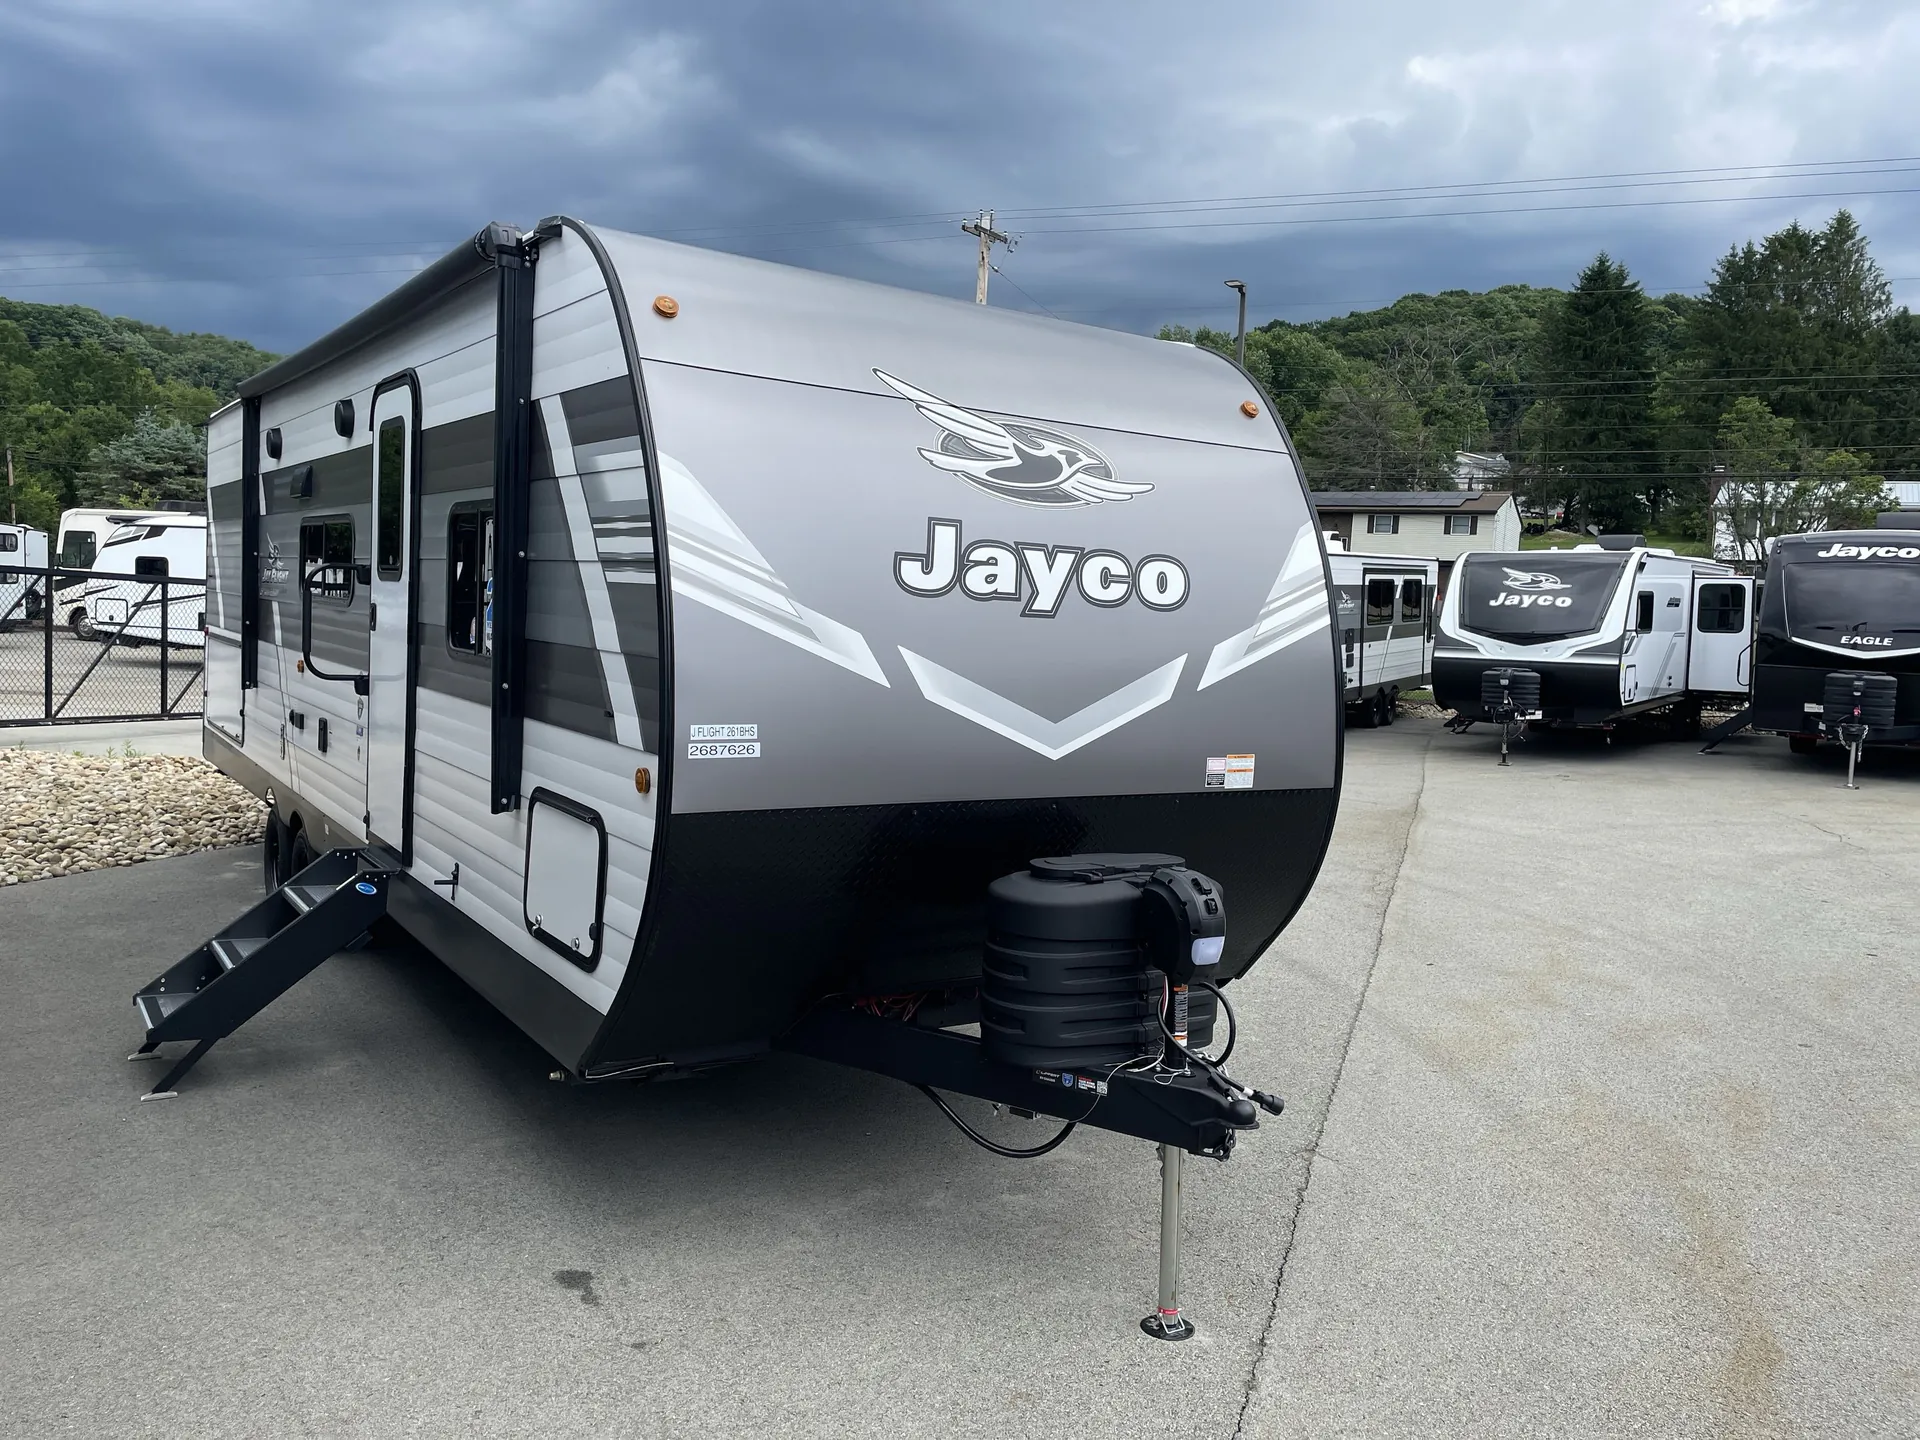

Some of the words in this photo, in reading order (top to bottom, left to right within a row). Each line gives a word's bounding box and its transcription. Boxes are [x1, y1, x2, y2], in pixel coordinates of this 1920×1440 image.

[1817, 543, 1920, 560] Jayco
[893, 516, 1191, 619] Jayco
[1489, 592, 1573, 608] Jayco
[1840, 635, 1894, 646] EAGLE
[691, 727, 696, 738] J
[697, 726, 726, 738] FLIGHT
[726, 726, 755, 737] 261BHS
[689, 744, 755, 756] 2687626
